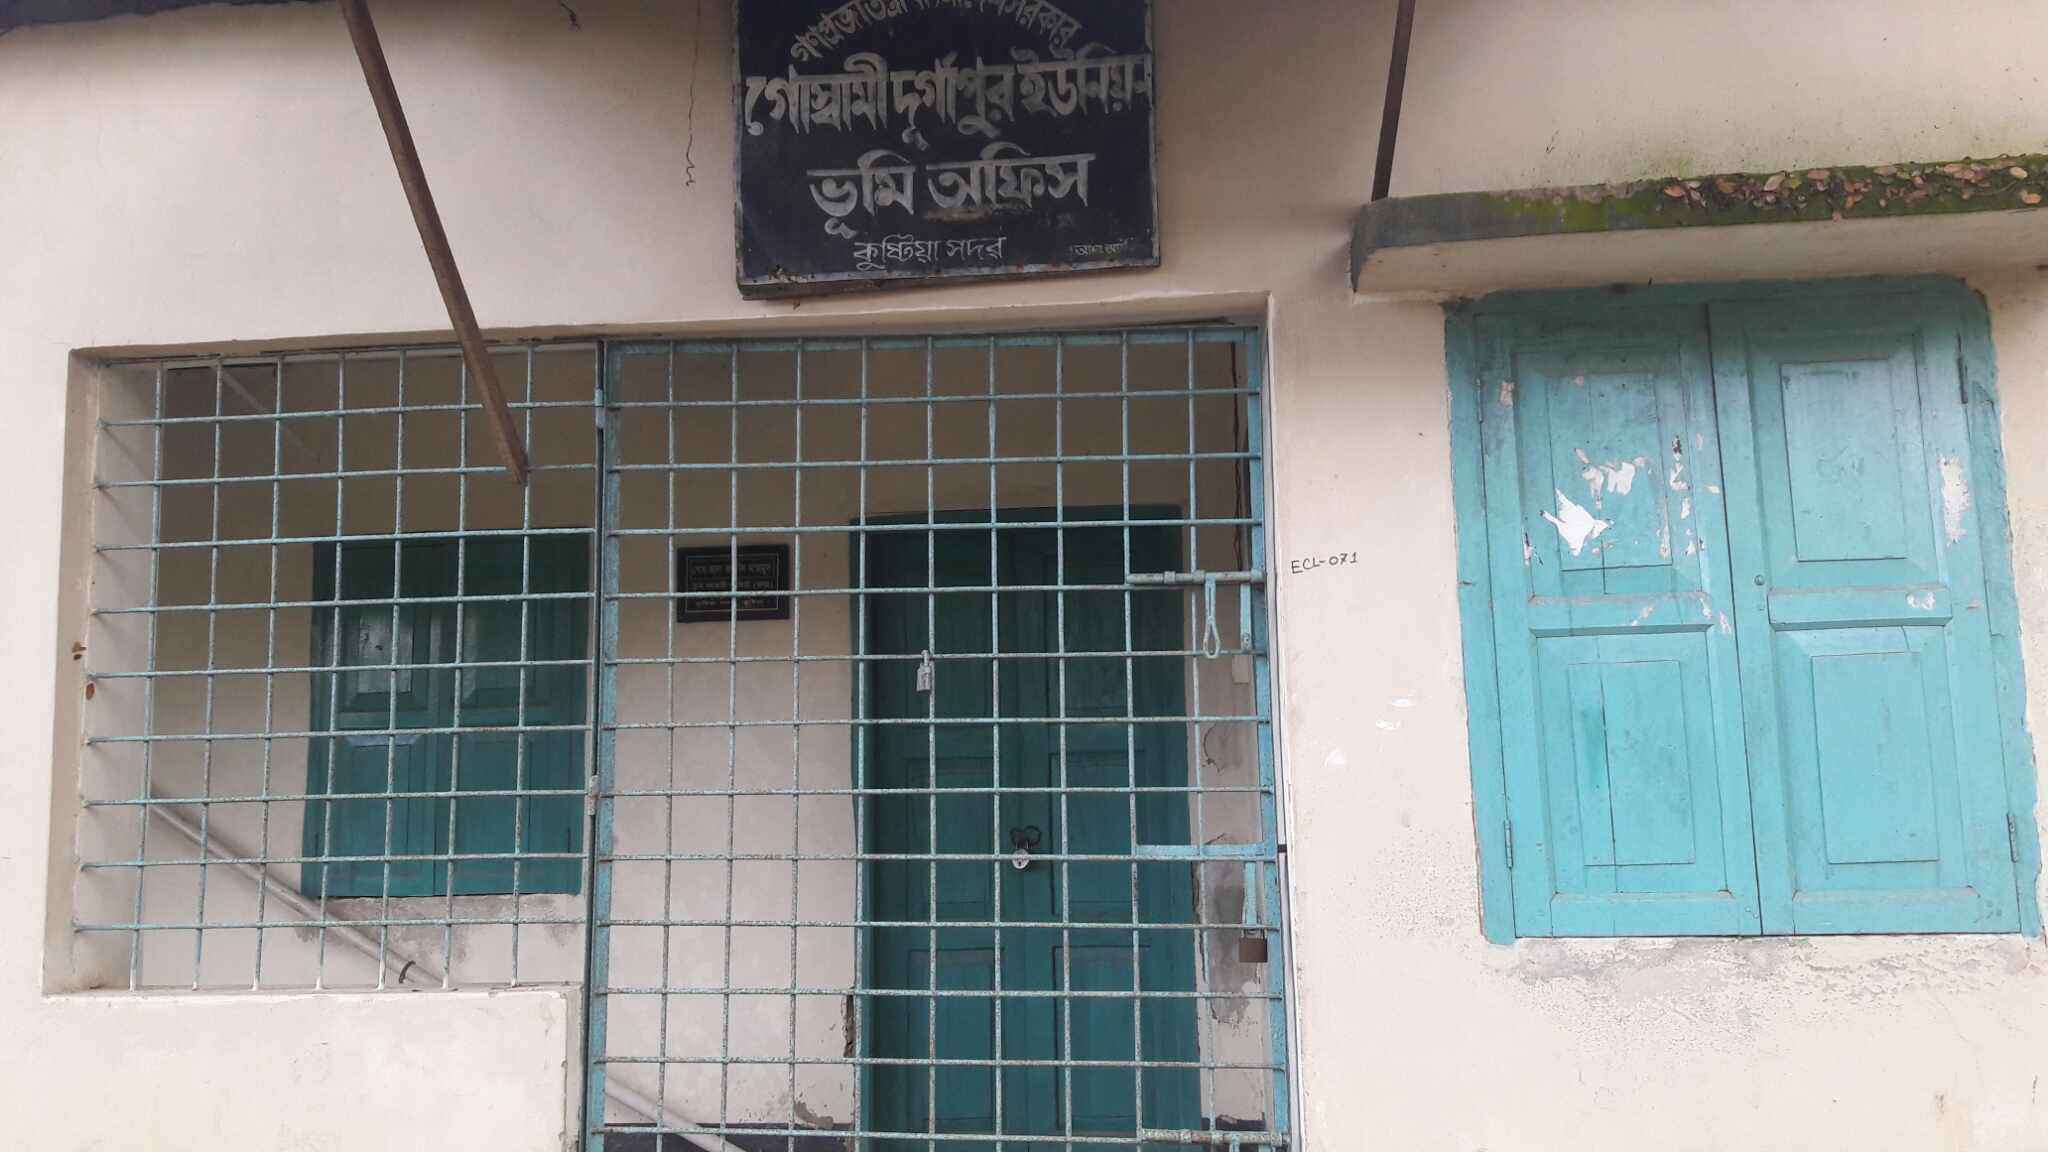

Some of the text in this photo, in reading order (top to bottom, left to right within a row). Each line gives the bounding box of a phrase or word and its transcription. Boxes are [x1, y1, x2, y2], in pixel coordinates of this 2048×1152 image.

[745, 52, 888, 136] গোস্বামী
[1010, 42, 1152, 118] ইউনিয়ন
[806, 142, 1096, 239] ভূমি অফিস
[853, 234, 1007, 270] কুষ্টিয়া সদর
[1290, 551, 1359, 575] ECL-071
